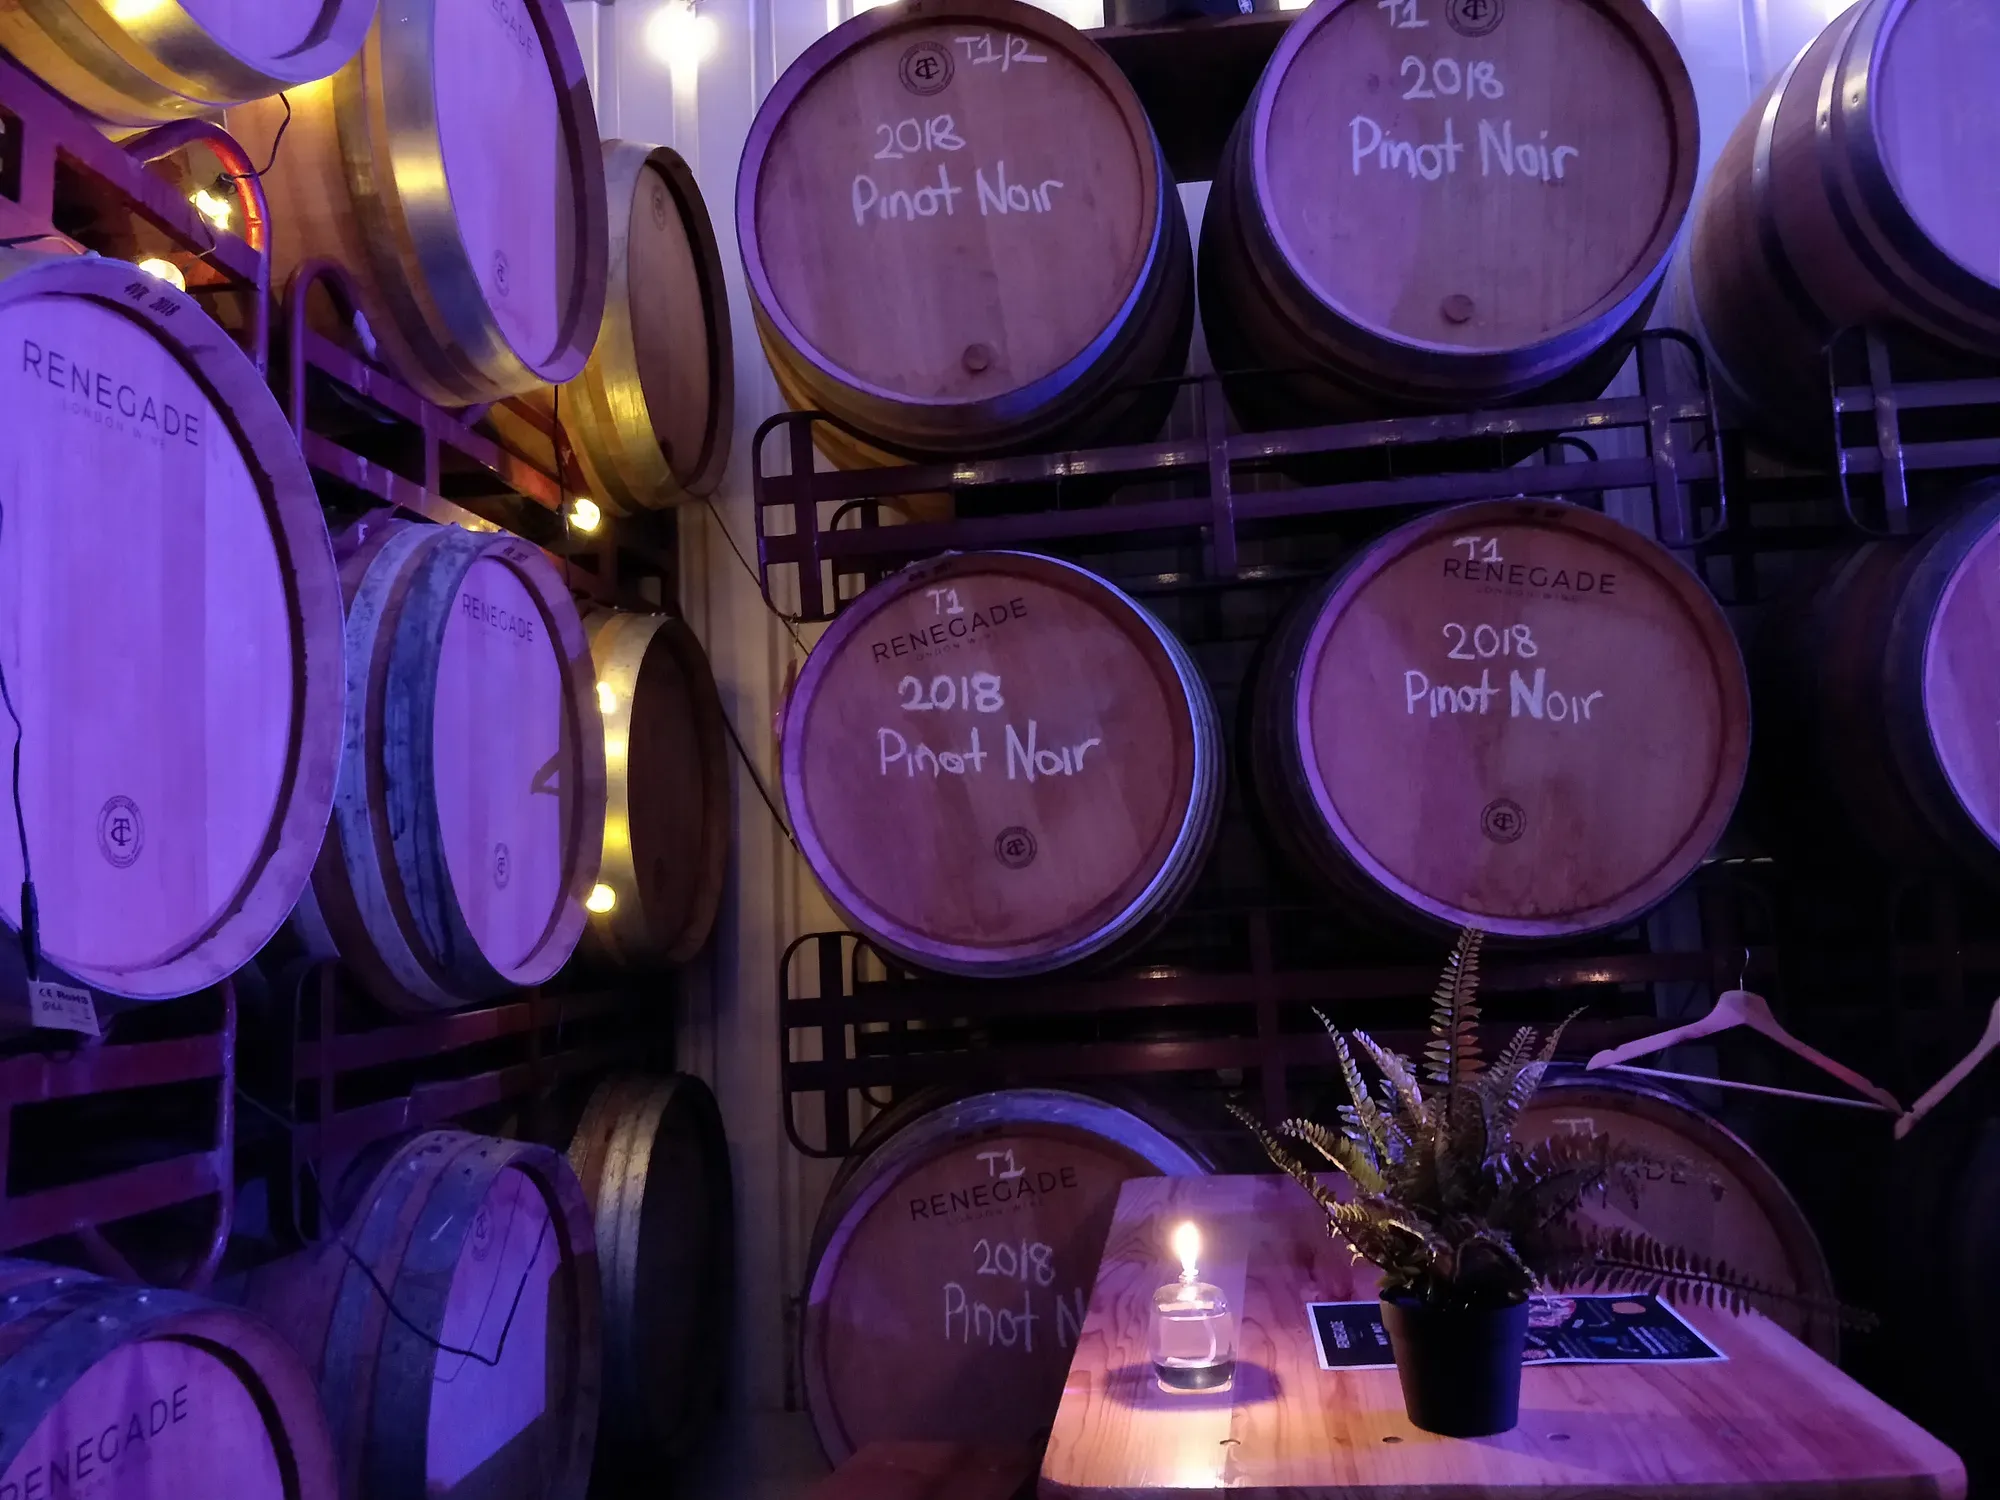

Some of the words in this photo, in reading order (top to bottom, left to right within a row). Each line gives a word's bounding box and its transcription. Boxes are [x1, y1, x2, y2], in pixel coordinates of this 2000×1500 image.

[1378, 0, 1429, 28] T1
[954, 33, 1047, 72] T1/2
[1400, 55, 1504, 100] 2018
[874, 114, 966, 159] 2018
[1349, 115, 1463, 181] Pinot
[1477, 118, 1578, 181] Noir
[852, 162, 962, 227] Pinot
[976, 160, 1064, 216] Noir
[23, 339, 199, 446] RENEGADE
[1453, 536, 1503, 562] T1
[1443, 558, 1617, 594] RENEGADE
[462, 593, 533, 642] RENEGADE
[926, 588, 964, 614] T1
[871, 597, 1028, 663] RENEGADE
[1442, 623, 1538, 660] 2018
[898, 671, 1004, 712] 2018
[1404, 668, 1500, 717] Pinot
[1509, 668, 1603, 723] Noir
[878, 726, 987, 778] Pinot
[1005, 719, 1101, 783] Noir
[976, 1149, 1026, 1178] T1
[910, 1166, 1078, 1221] RENEGADE
[973, 1238, 1056, 1287] 2018
[943, 1281, 1039, 1352] Pinot
